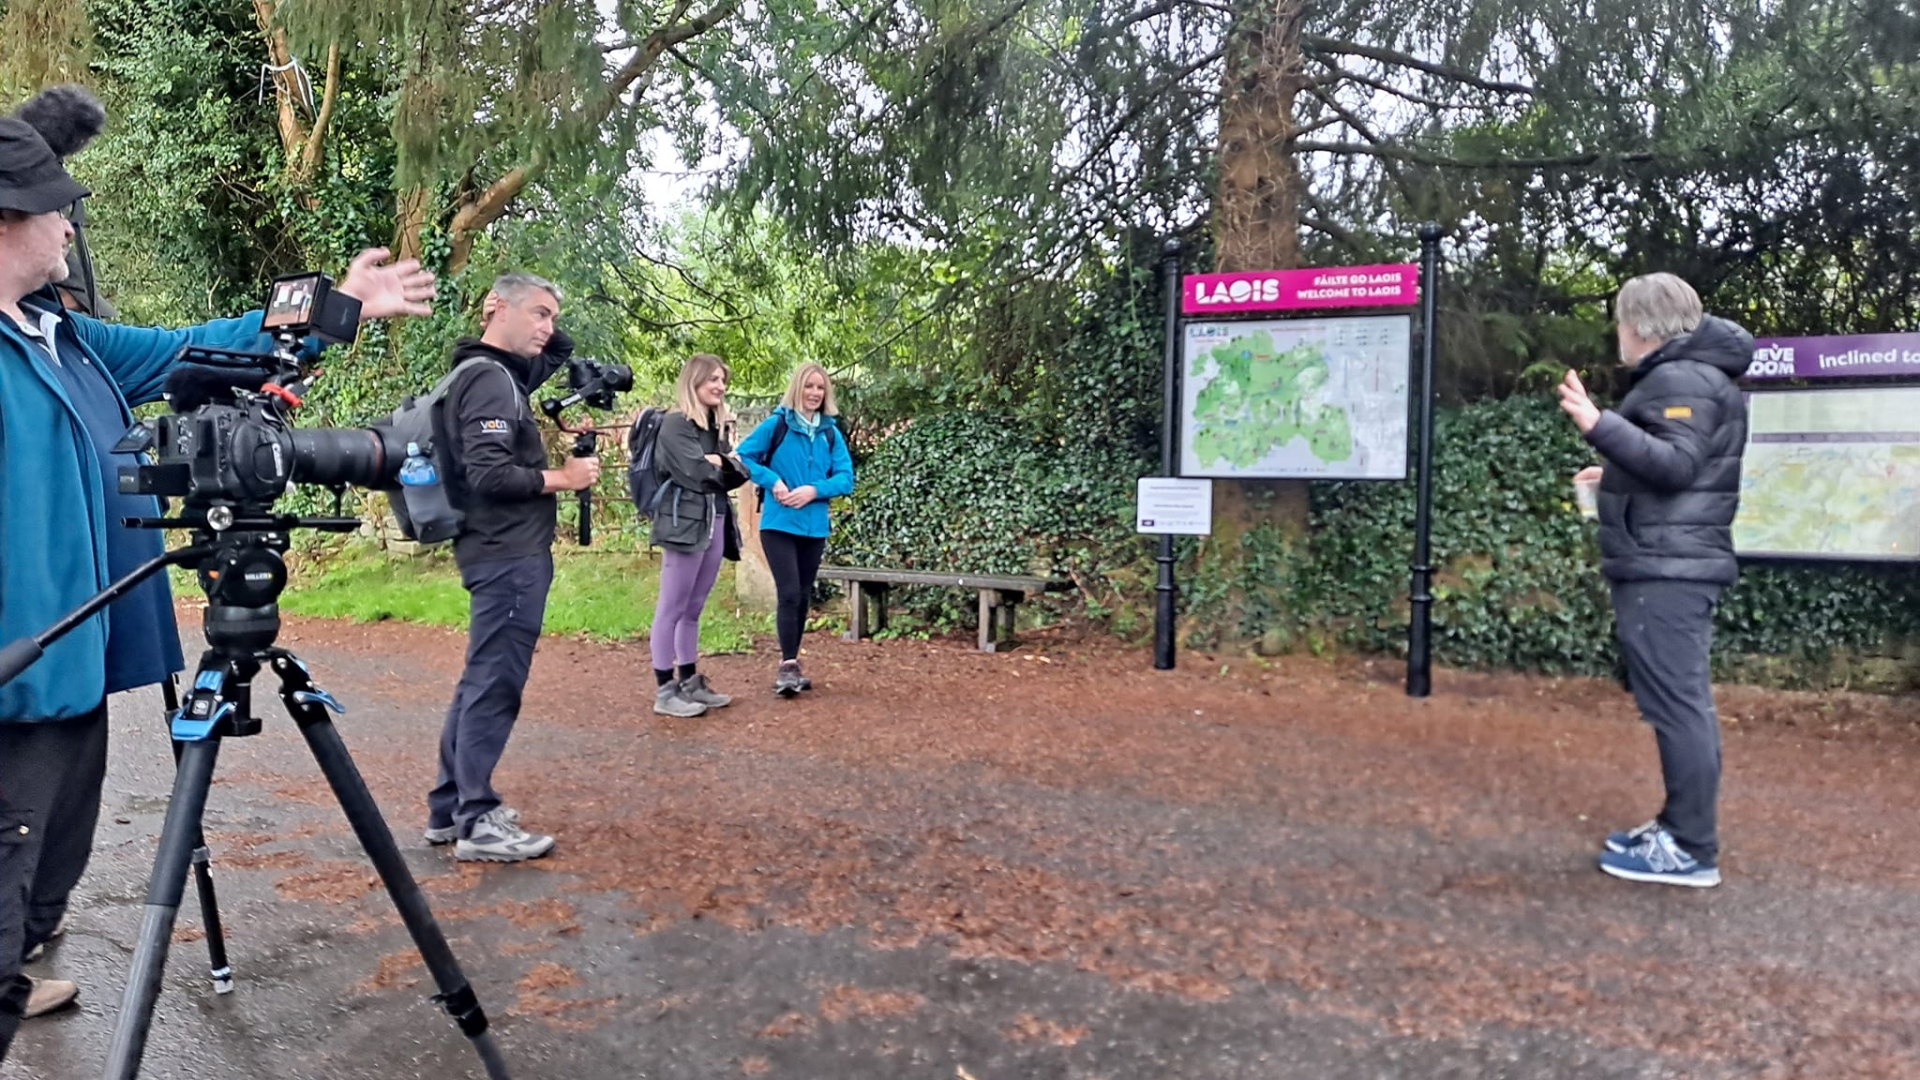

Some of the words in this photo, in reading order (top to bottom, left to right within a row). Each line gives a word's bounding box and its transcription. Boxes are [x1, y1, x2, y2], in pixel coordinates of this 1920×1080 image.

[1314, 274, 1348, 286] FÁILTE
[1350, 275, 1367, 284] GO
[1369, 273, 1402, 283] LAOIS
[1196, 279, 1280, 304] LAOIS
[1297, 288, 1350, 299] WELCOME
[1352, 287, 1368, 297] TO
[1368, 285, 1401, 296] LAOIS
[1748, 361, 1795, 375] OOM
